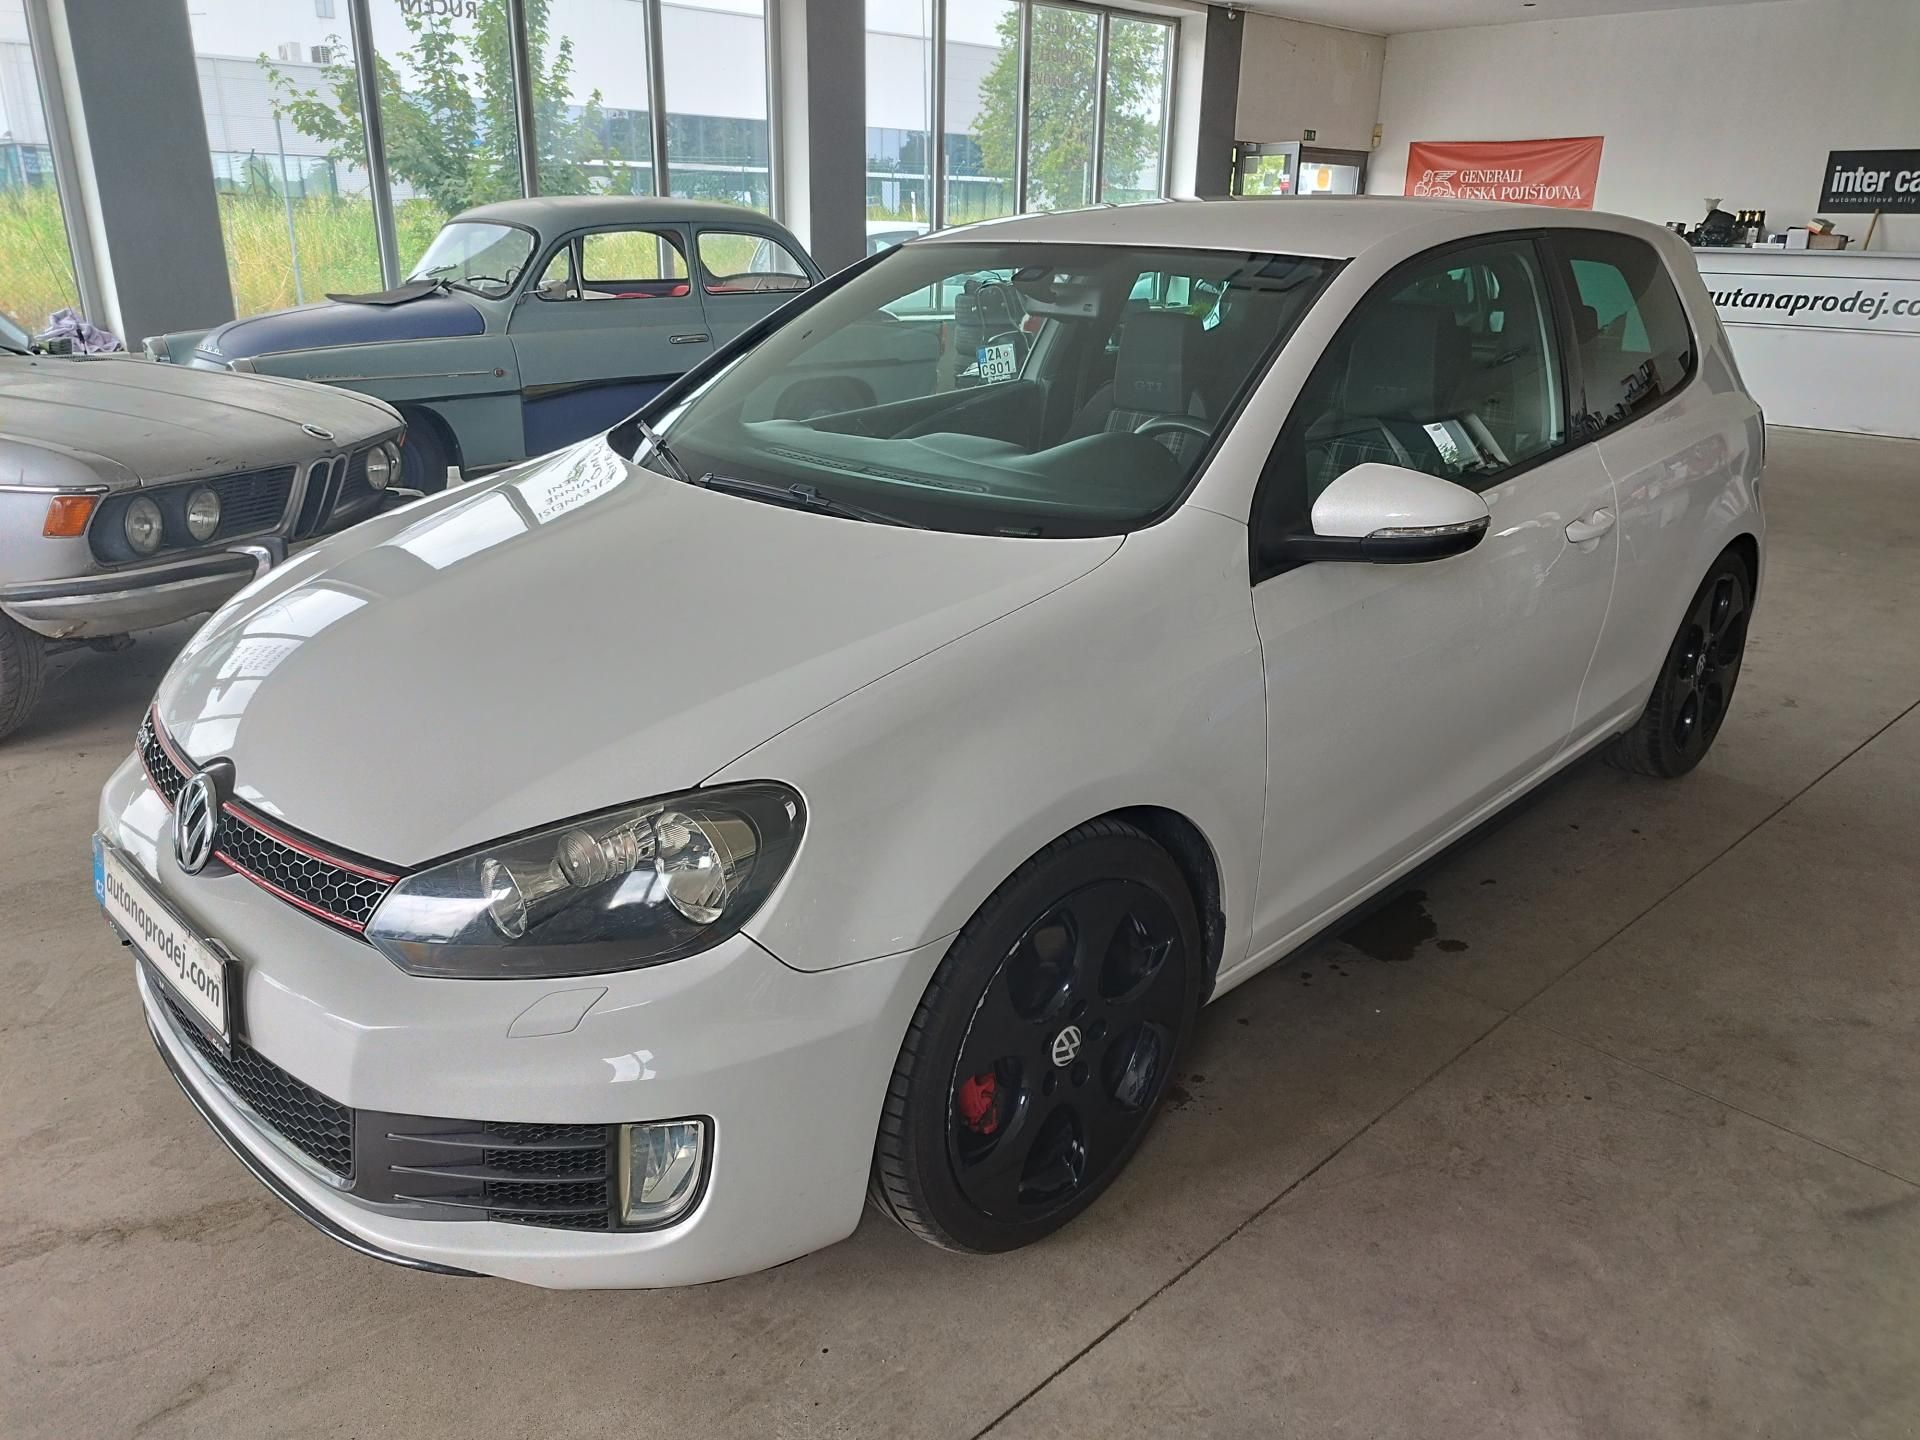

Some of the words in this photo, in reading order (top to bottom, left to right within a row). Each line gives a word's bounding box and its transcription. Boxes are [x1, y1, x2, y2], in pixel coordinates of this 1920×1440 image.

[1459, 169, 1523, 183] GENERALI
[1831, 165, 1891, 193] inter
[1457, 183, 1496, 199] ČESKÁ
[1501, 183, 1581, 200] POJIŠŤOVNA
[987, 347, 1002, 361] 2A
[982, 360, 1011, 376] C901
[106, 872, 220, 1008] autanaprodej.com
